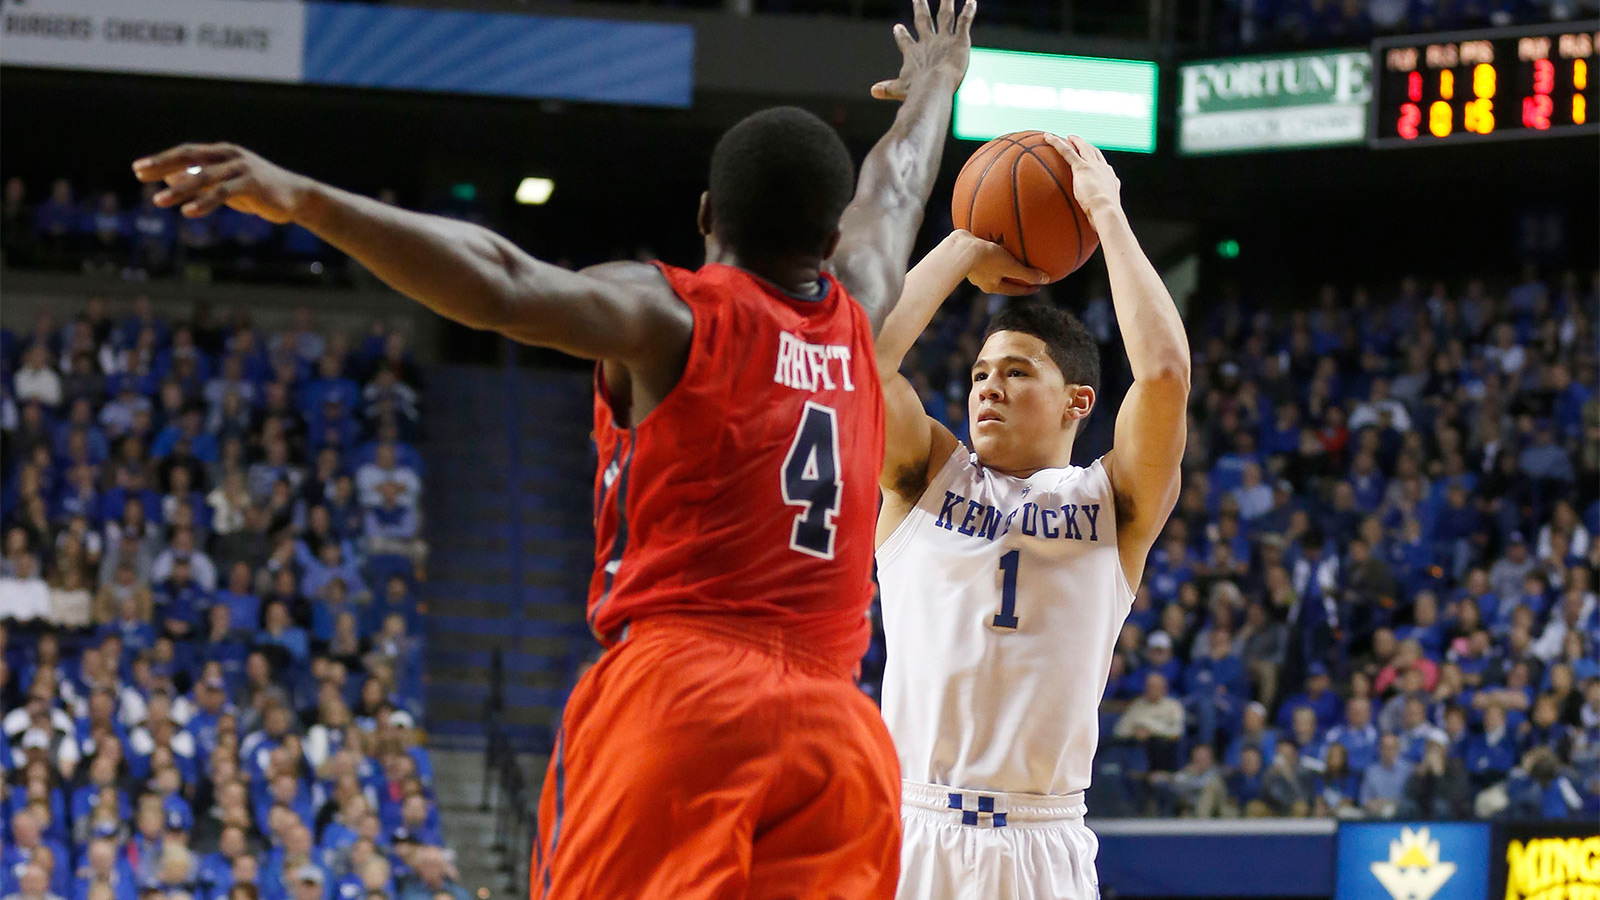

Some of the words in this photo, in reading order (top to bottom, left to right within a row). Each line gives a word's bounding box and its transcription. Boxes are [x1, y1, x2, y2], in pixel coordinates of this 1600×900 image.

[1180, 51, 1373, 116] FORTUNE
[1440, 68, 1454, 100] 1
[1573, 58, 1587, 90] 1
[1397, 102, 1421, 140] 2
[1572, 93, 1586, 125] 1
[780, 400, 844, 560] 4
[993, 550, 1020, 629] 1
